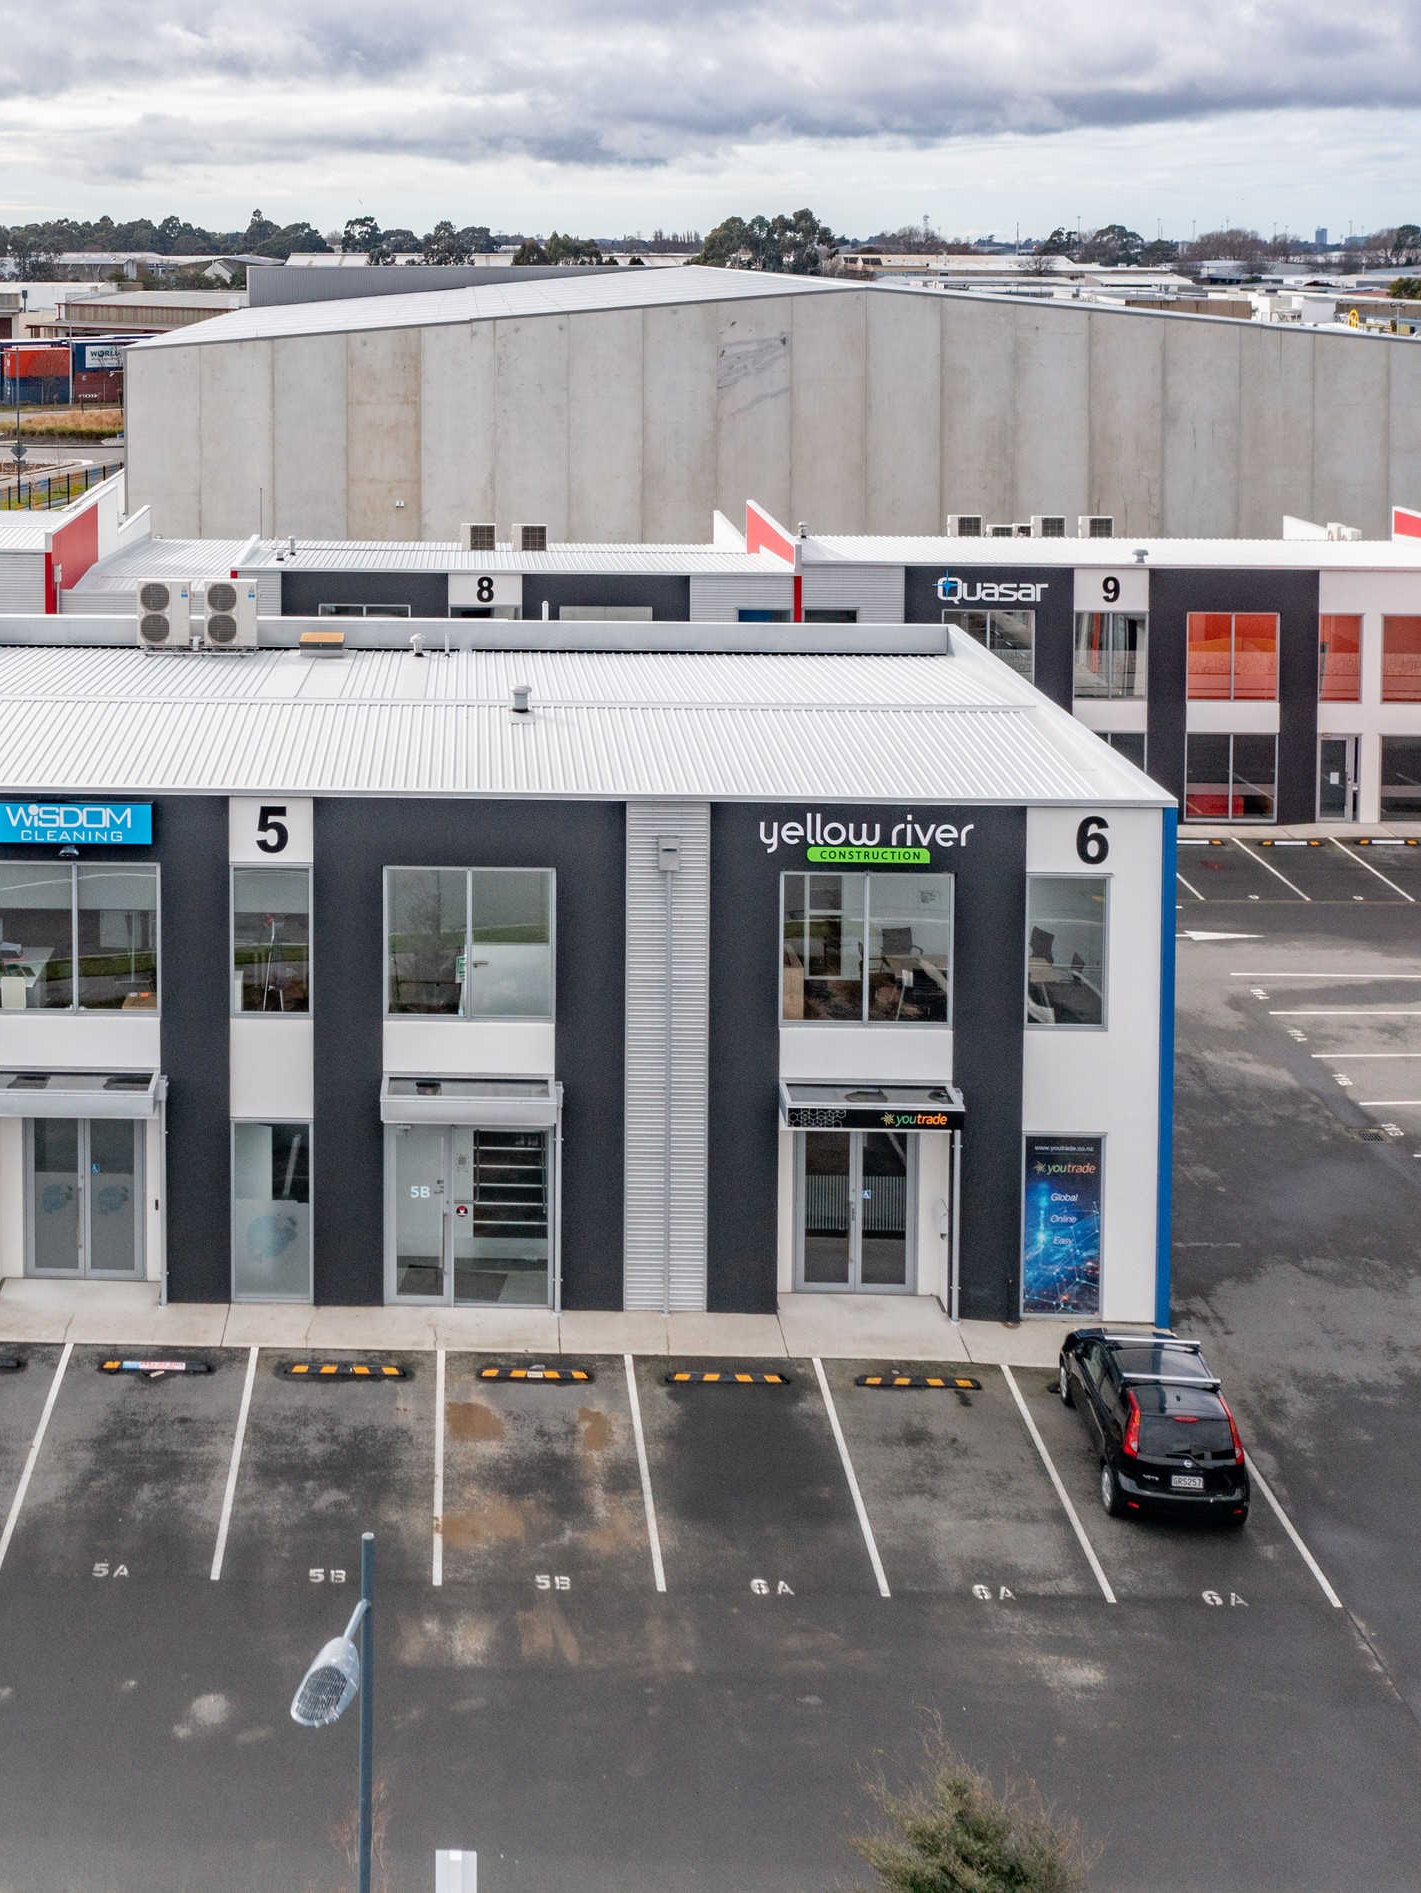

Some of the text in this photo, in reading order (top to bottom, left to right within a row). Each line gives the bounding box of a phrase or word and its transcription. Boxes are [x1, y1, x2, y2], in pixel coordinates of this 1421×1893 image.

[476, 576, 494, 603] 8
[936, 576, 1049, 605] Quasar
[1102, 576, 1121, 603] 9
[20, 830, 123, 842] CLEANING
[255, 805, 289, 854] 5
[759, 813, 974, 853] yellow river
[1075, 815, 1110, 865] 6
[820, 849, 921, 861] CONSTRUCTION
[895, 1112, 948, 1127] youtrade
[1046, 1162, 1096, 1175] youtrade
[410, 1185, 431, 1198] 5B
[1050, 1192, 1078, 1202] Global
[1050, 1214, 1077, 1223] Online
[1053, 1235, 1074, 1245] Easy
[1173, 1477, 1202, 1487] GRS257
